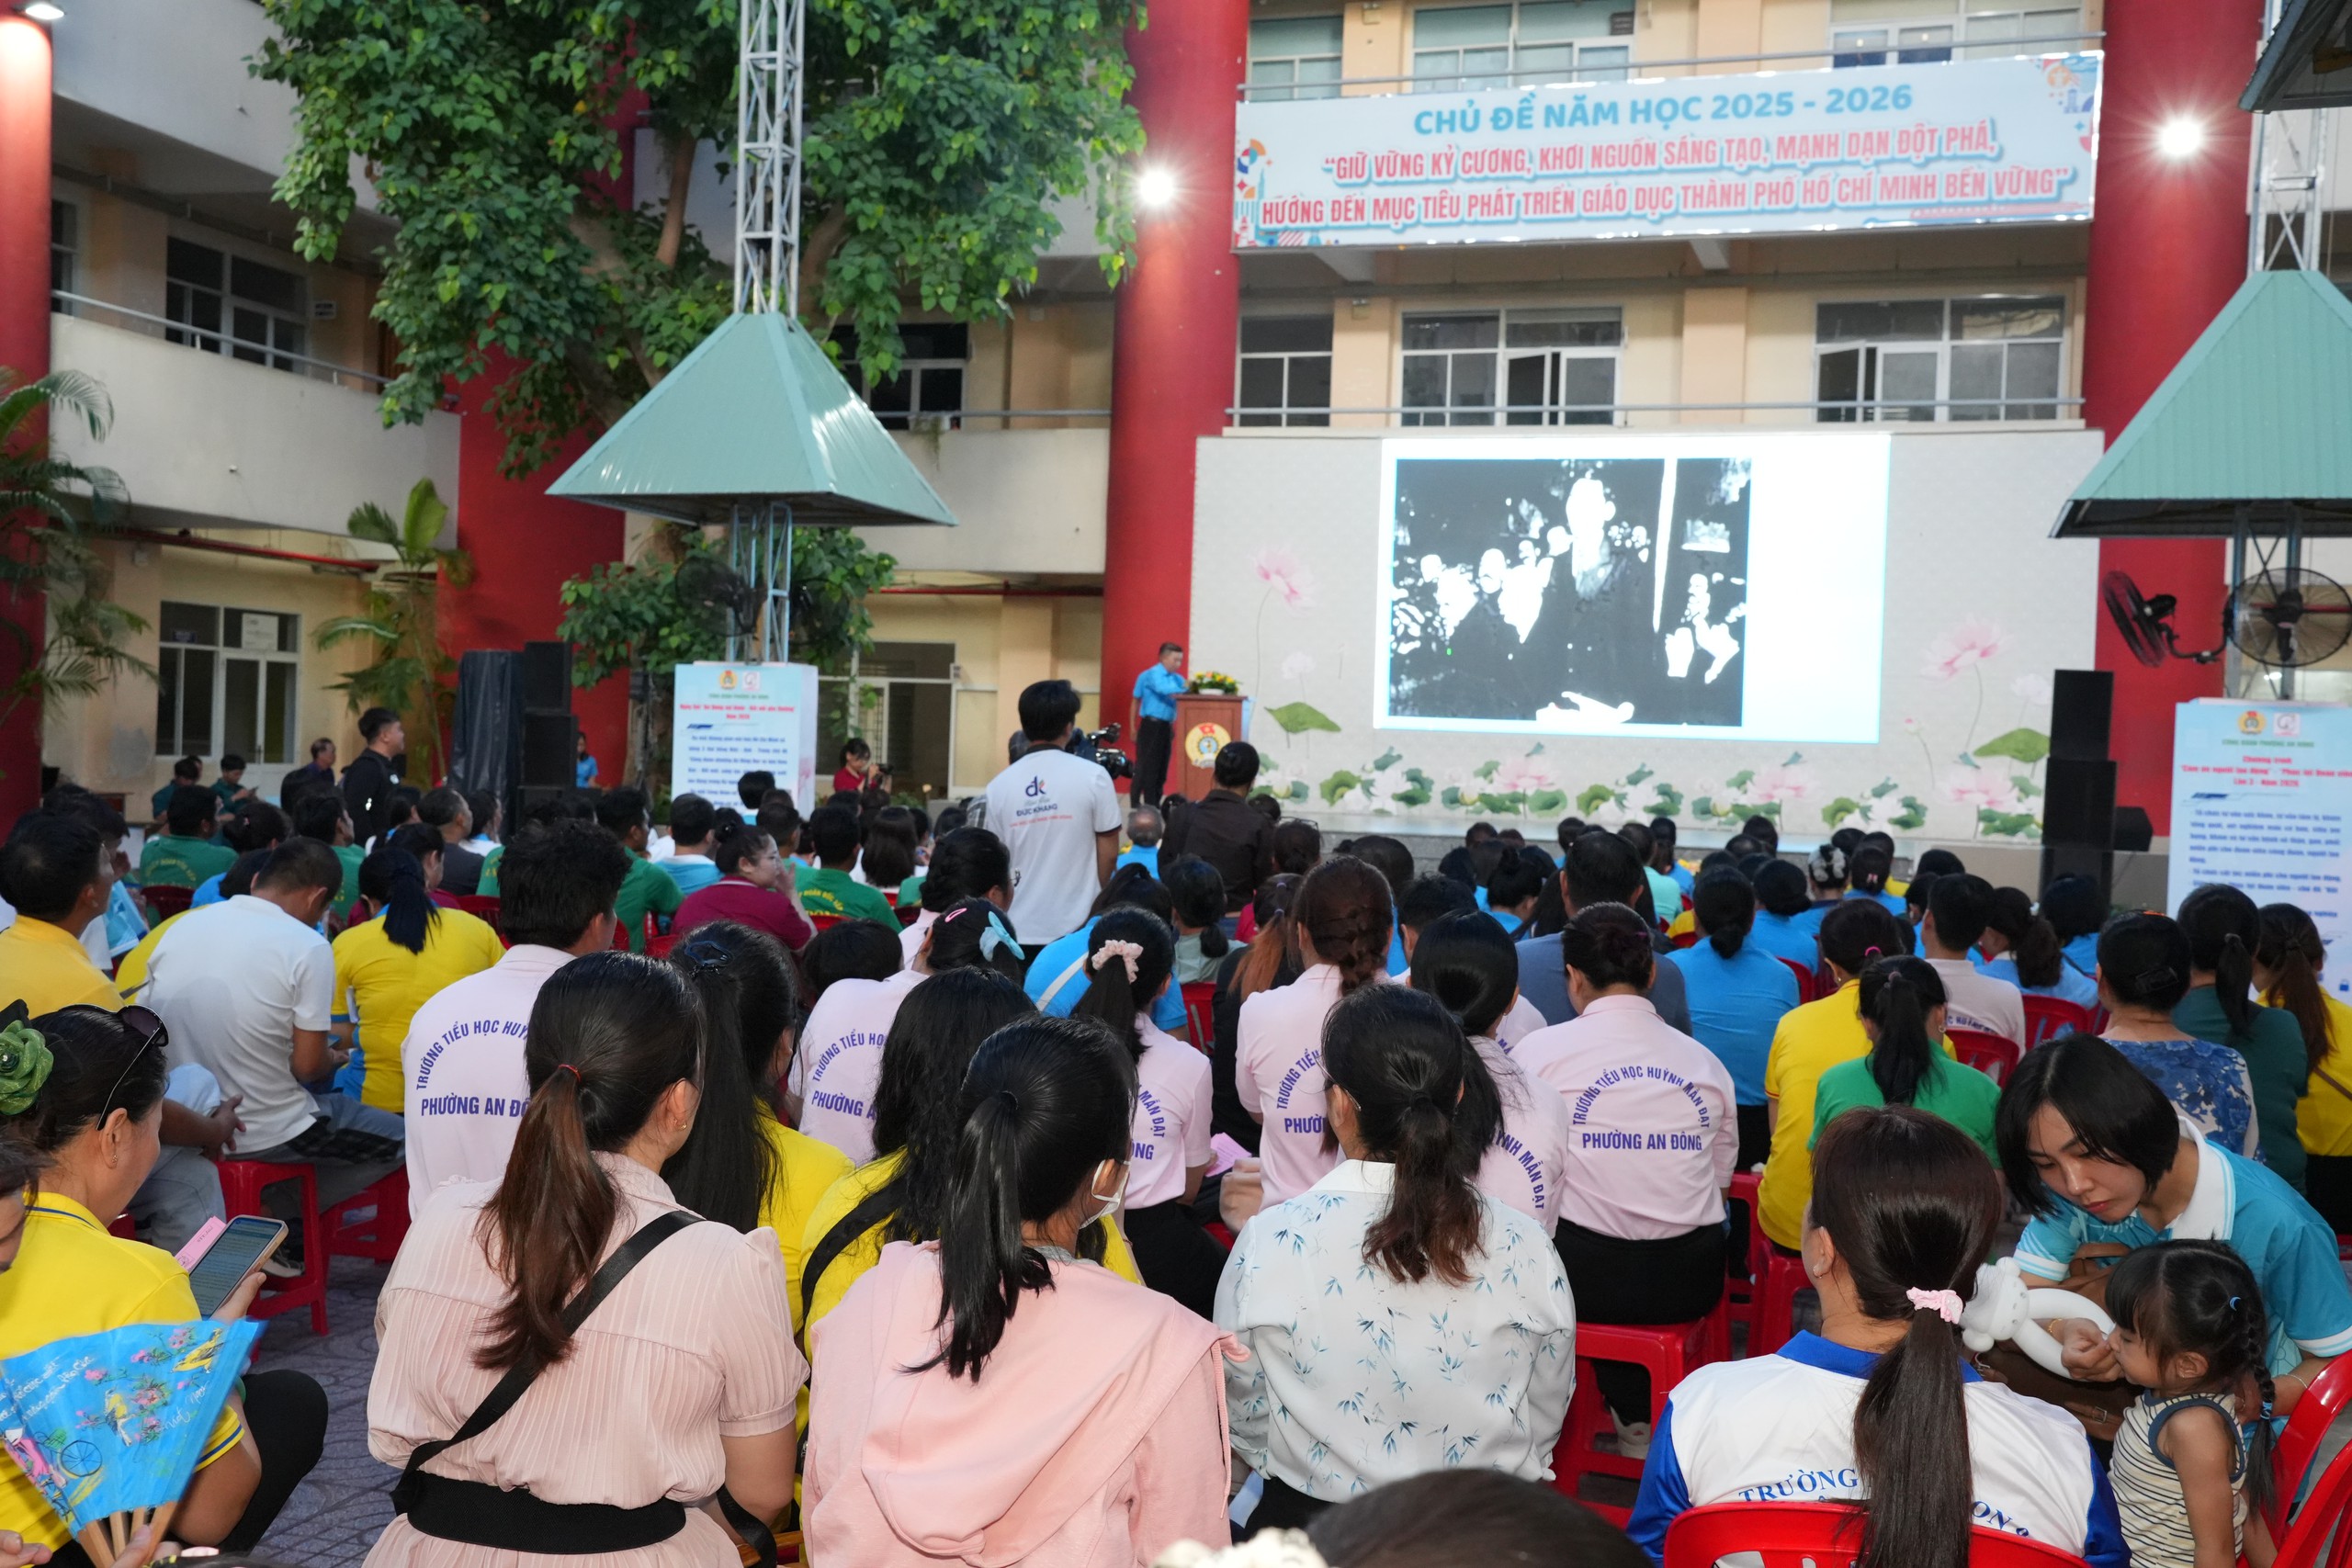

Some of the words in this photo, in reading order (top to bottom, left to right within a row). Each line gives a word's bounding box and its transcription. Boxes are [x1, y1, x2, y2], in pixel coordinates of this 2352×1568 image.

[1415, 100, 1480, 135] CHỦ
[1490, 93, 1536, 131] ĐỀ
[1544, 96, 1619, 128] NĂM
[1630, 96, 1702, 130] HỌC
[1712, 92, 1793, 120] 2025
[1826, 85, 1913, 114] 2026
[1374, 149, 1424, 177] VỮNG
[1461, 147, 1532, 176] CƯƠNG,
[1539, 143, 1584, 172] KHƠI
[1664, 132, 1717, 165] SÁNG
[1724, 136, 1769, 167] TẠO,
[1776, 133, 1838, 165] MẠNH
[1848, 130, 1890, 162] DẠN
[1897, 123, 1939, 160] ĐỘT
[1945, 119, 1996, 153] PHÁ,
[1262, 194, 1324, 225] HƯỚNG
[1330, 191, 1366, 222] ĐẾN
[1373, 194, 1416, 225] MỤC
[1423, 188, 1461, 220] TIÊU
[1467, 186, 1517, 218] PHÁT
[1521, 183, 1575, 215] TRIỂN
[1582, 183, 1627, 213] GIÁO
[1634, 186, 1673, 216] DỤC
[1681, 177, 1747, 209] THÀNH
[1754, 174, 1794, 207] PHỐ
[1838, 171, 1873, 203] CHÍ
[1880, 175, 1936, 201] MINH
[416, 1042, 444, 1090] TRƯỜNG
[442, 1021, 469, 1045] TIỂU
[473, 1020, 500, 1037] HỌC
[812, 1043, 841, 1082] TRƯỜNG
[840, 1029, 865, 1050] TIỂU
[868, 1032, 885, 1049] HỌ
[421, 1092, 480, 1117] PHƯỜNG
[484, 1098, 505, 1116] AN
[509, 1097, 531, 1118] ĐÔ
[811, 1090, 864, 1117] PHƯỜNG
[865, 1102, 878, 1121] A
[1276, 1068, 1301, 1110] TRƯỜNG
[1573, 1086, 1600, 1125] TRƯỜNG
[1595, 1068, 1621, 1089] TIỂU
[1621, 1066, 1644, 1081] HỌC
[1646, 1066, 1685, 1087] HUỲNH
[1698, 1107, 1710, 1128] ĐẠT
[1150, 1117, 1166, 1138] ĐẠT
[1284, 1113, 1328, 1134] PHƯỜ
[1582, 1129, 1642, 1149] PHƯỜNG
[1646, 1134, 1666, 1150] AN
[1670, 1131, 1702, 1151] ĐÔNG
[1532, 1184, 1545, 1210] ĐẠT
[1738, 1468, 1859, 1502] TRƯỜNG
